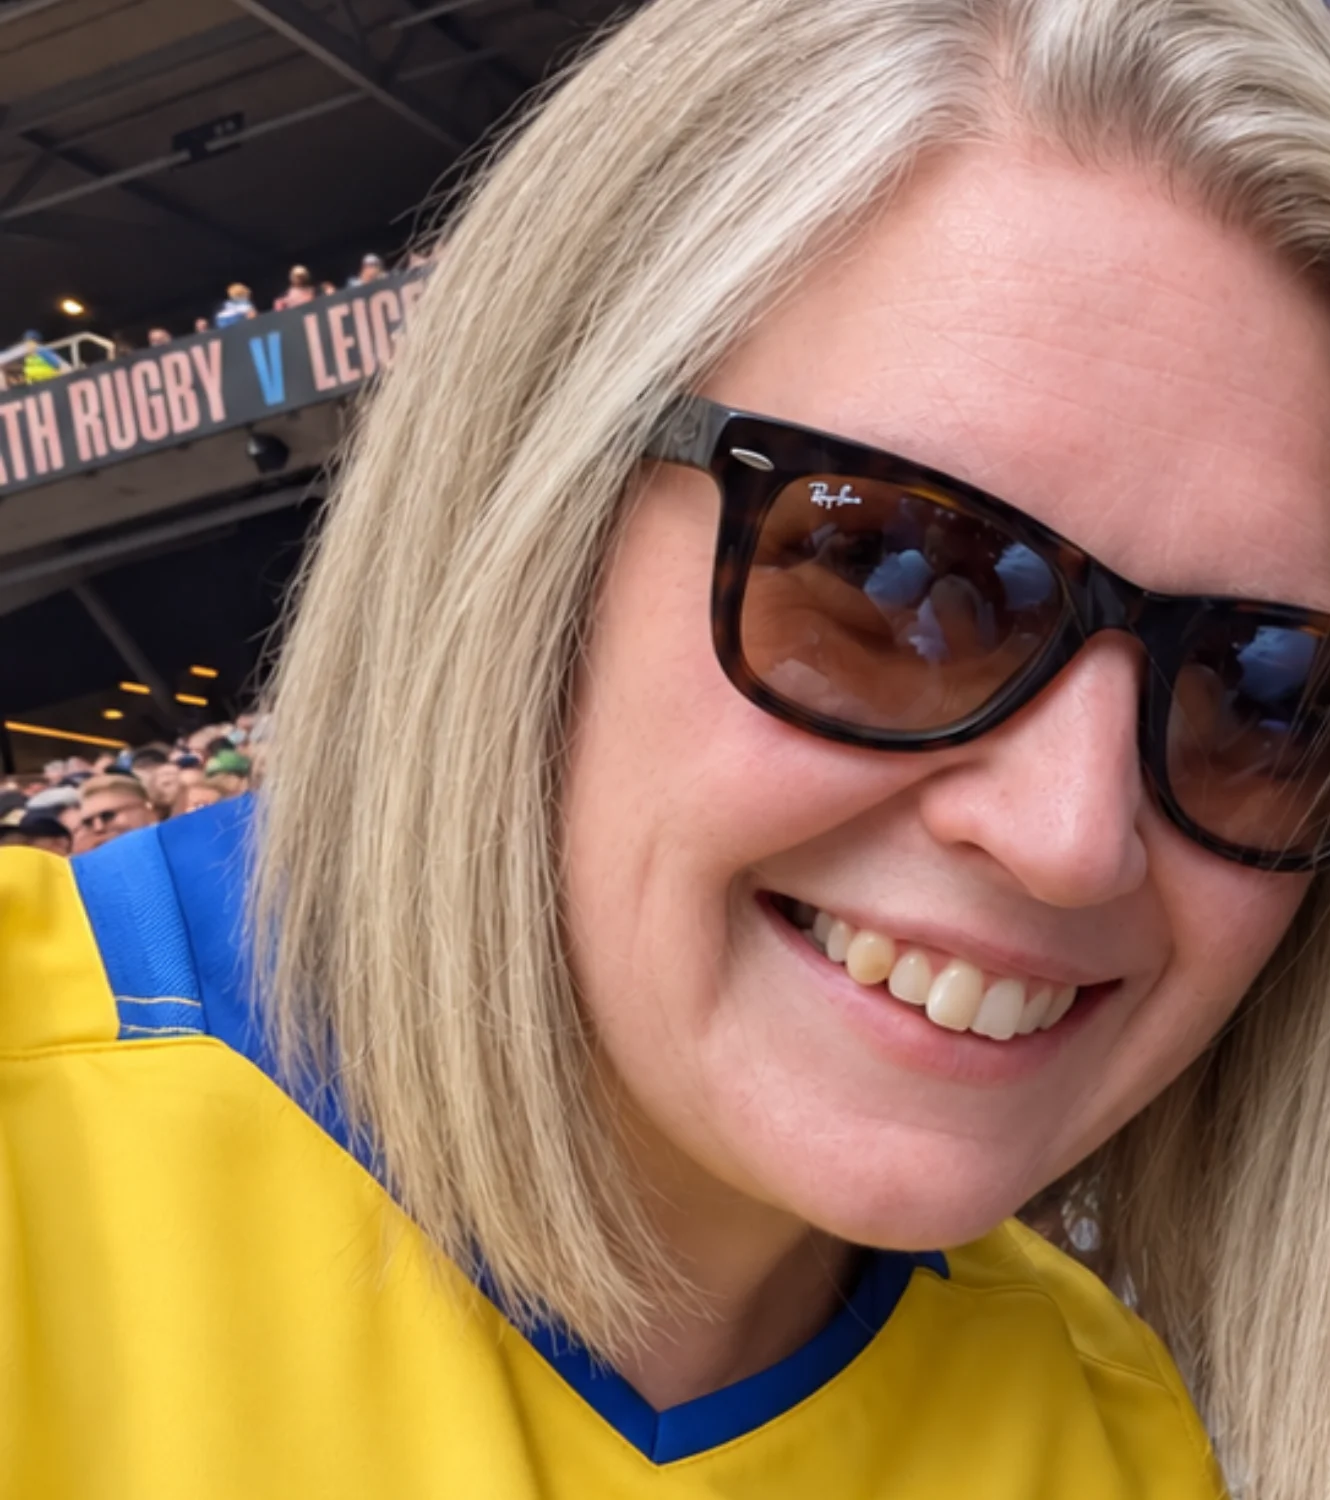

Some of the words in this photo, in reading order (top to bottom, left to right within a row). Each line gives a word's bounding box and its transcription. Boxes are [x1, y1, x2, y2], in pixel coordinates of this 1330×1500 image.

[0, 391, 64, 485] TH
[68, 339, 226, 462] RUGBY
[249, 331, 285, 406] V
